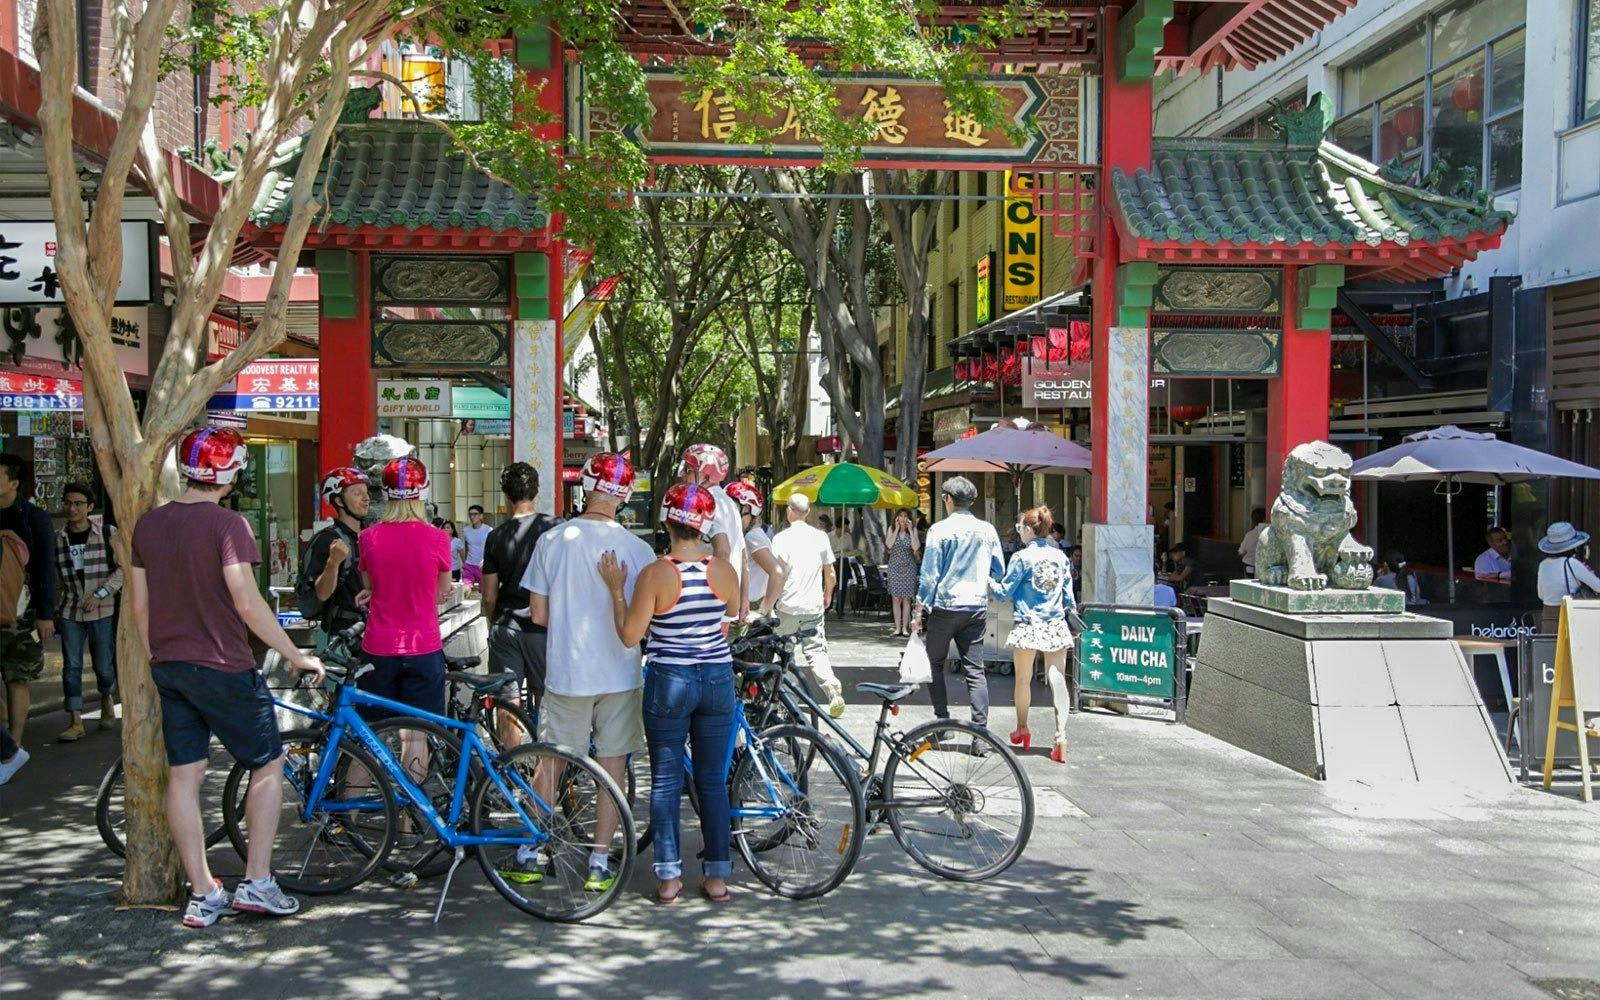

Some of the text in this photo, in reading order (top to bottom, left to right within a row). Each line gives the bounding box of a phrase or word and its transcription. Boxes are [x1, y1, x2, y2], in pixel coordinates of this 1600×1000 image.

[922, 26, 952, 40] RUST
[1006, 295, 1038, 304] RESTAURANT
[280, 365, 307, 375] REALTY
[1034, 380, 1091, 389] GOLDEN
[381, 387, 441, 401] 礼品店
[1034, 390, 1091, 399] RESTAU
[276, 396, 312, 408] 9211
[383, 404, 441, 413] GIFT WORLD
[1121, 625, 1156, 643] DAILY
[1089, 623, 1104, 681] 天天茶市
[1109, 647, 1168, 668] YUM CHA
